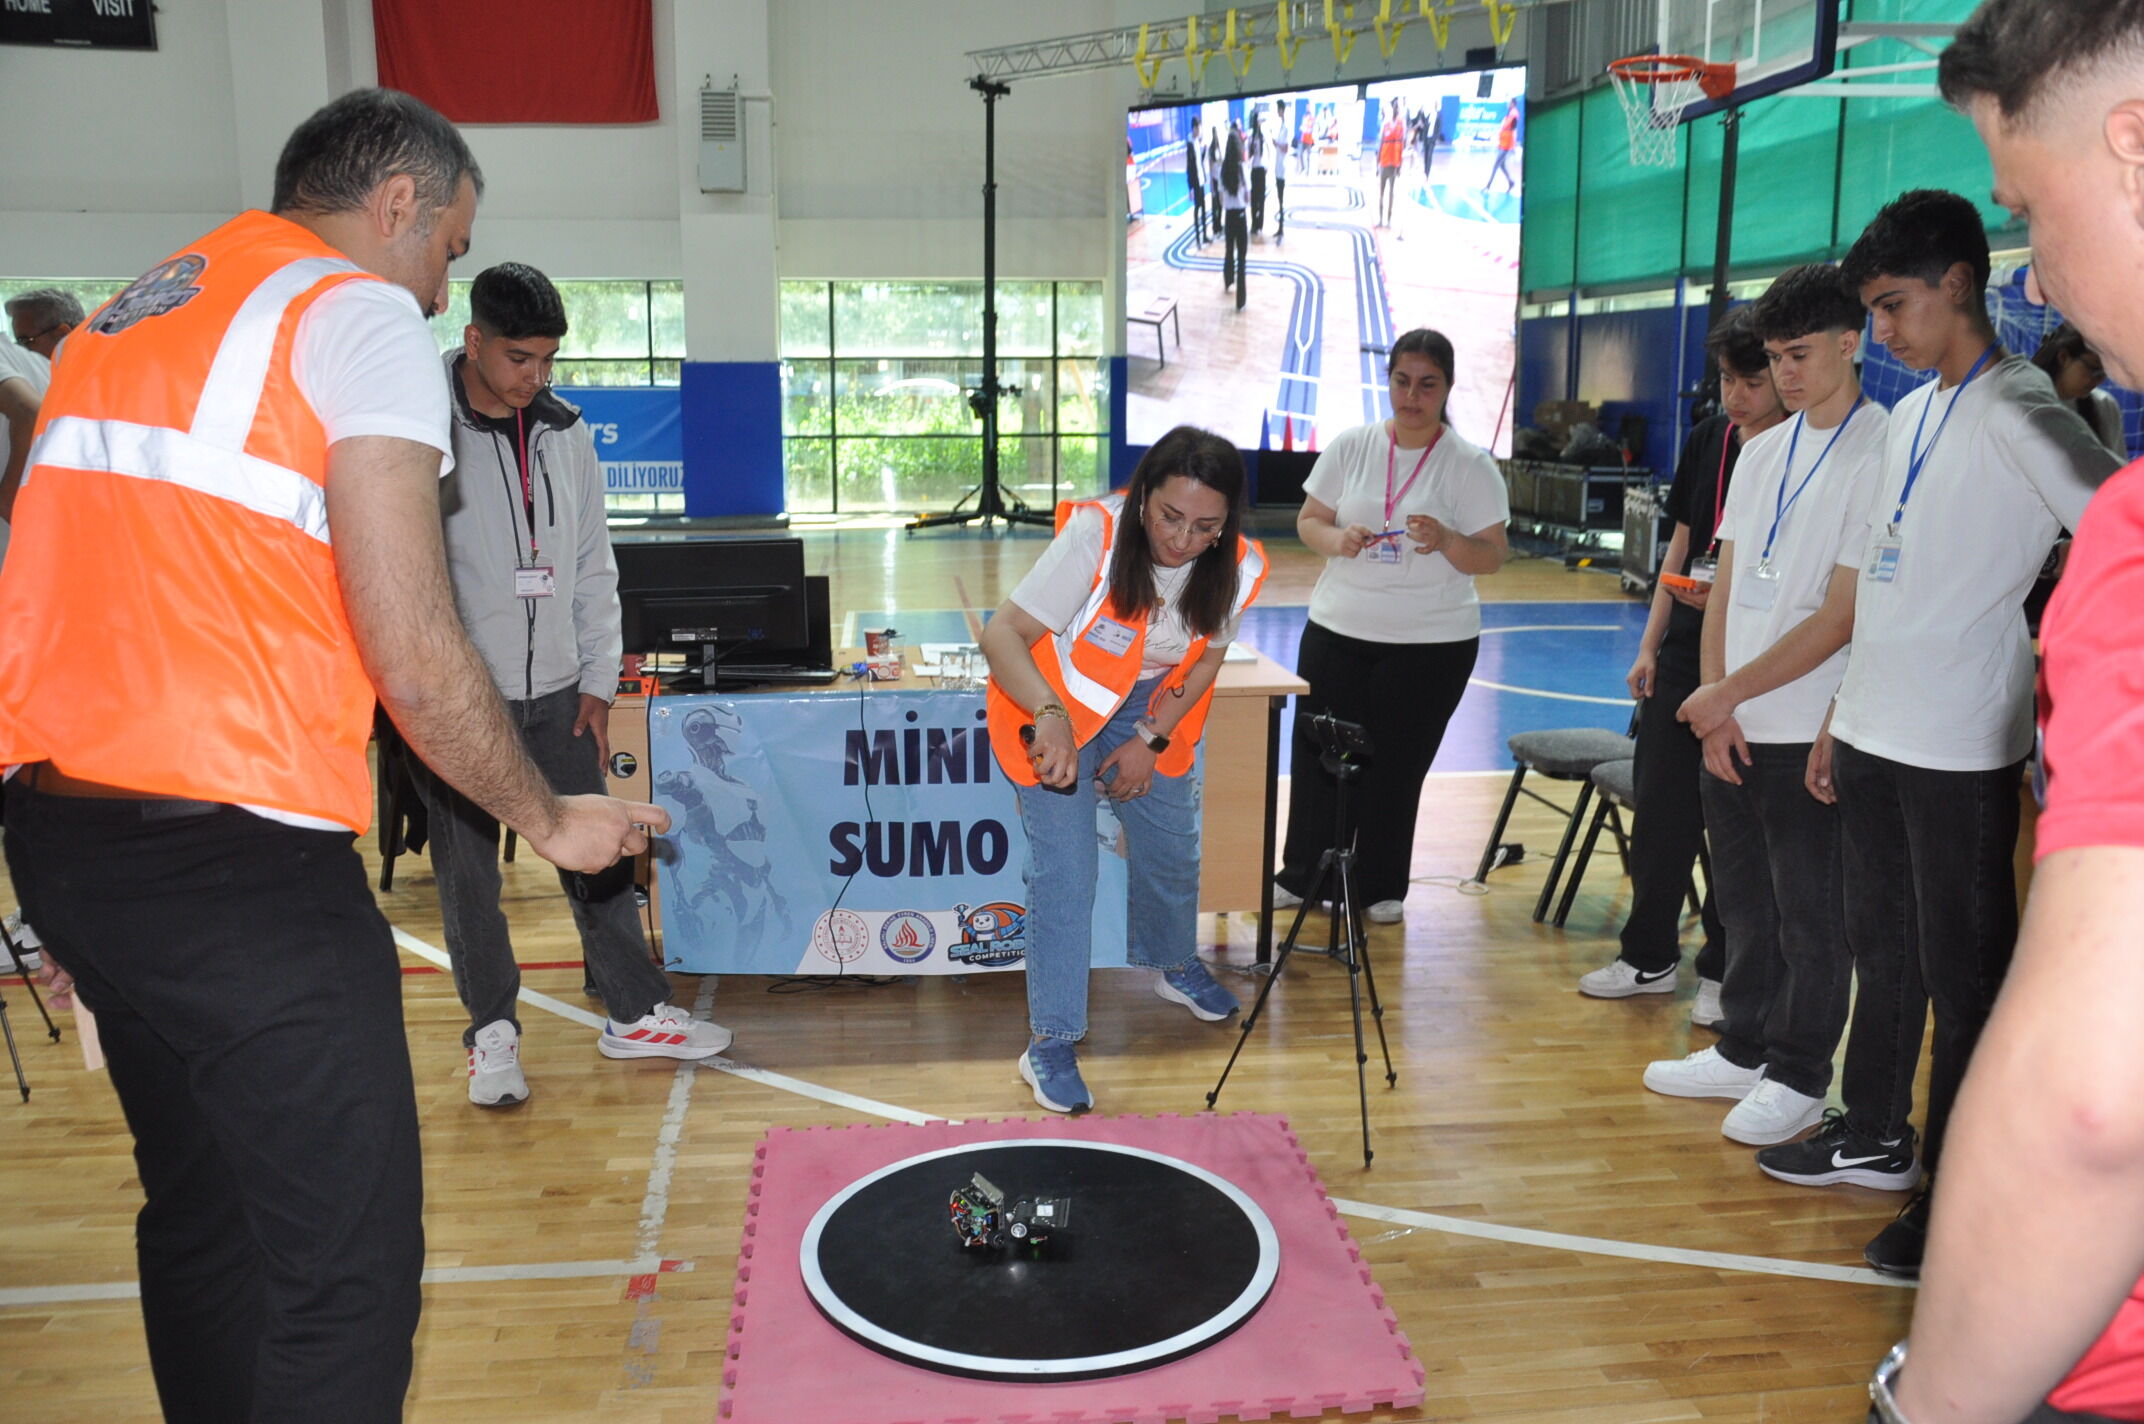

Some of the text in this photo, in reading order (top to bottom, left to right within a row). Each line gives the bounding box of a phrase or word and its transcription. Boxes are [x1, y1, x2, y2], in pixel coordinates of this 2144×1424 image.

[92, 0, 133, 16] VISIT
[829, 819, 1009, 878] SUMO
[950, 938, 1025, 958] SEAL ROB
[969, 949, 1025, 961] COMPETITIO
